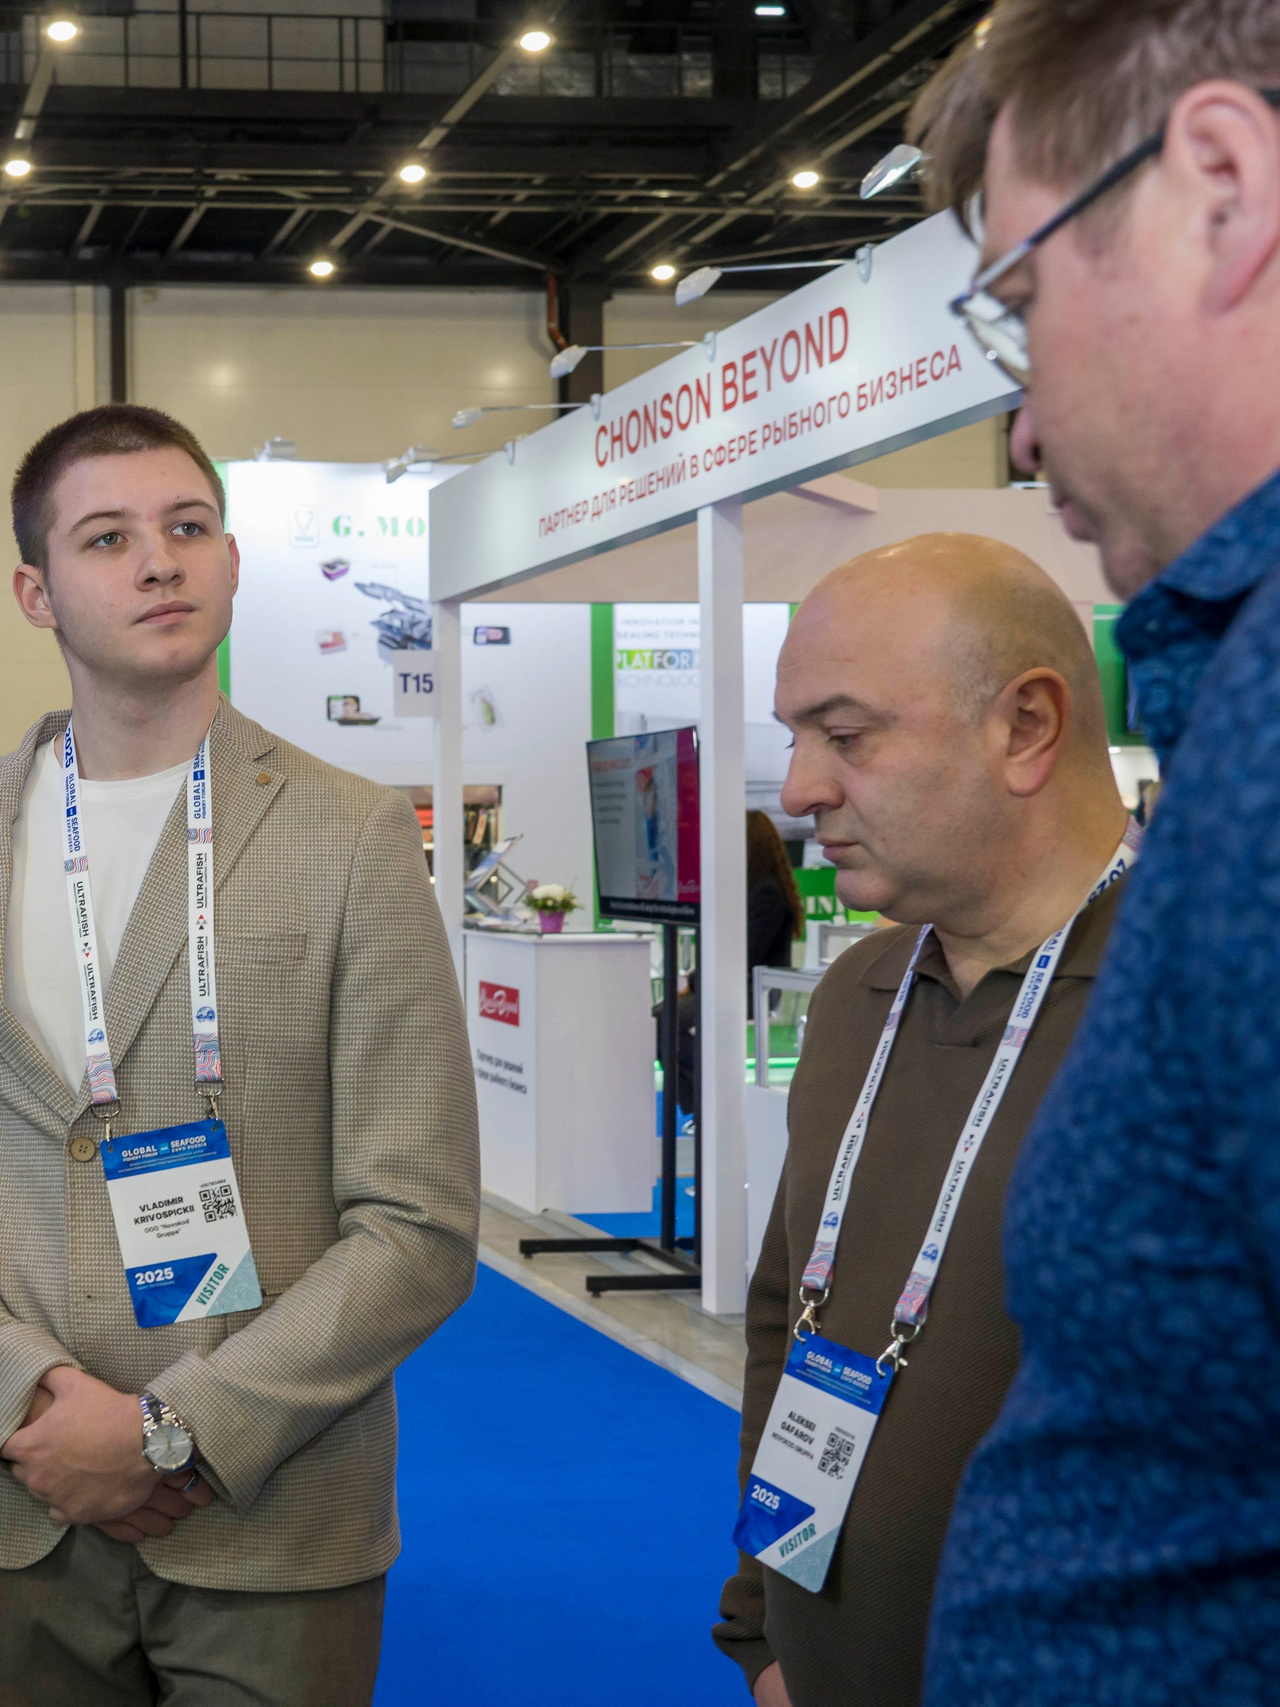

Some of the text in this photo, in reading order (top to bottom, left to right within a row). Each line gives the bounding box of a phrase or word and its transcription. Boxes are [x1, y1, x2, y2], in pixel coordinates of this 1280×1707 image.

[595, 306, 849, 467] CHONSON BEYOND
[538, 344, 962, 538] ПАРТНЕР ДЛЯ РЕШЕНИЙ В СФЕРЕ РЫБНОГО БИЗНЕСА
[399, 672, 434, 694] T15
[68, 772, 77, 806] GLOBAL
[193, 782, 201, 820] GLOBAL
[71, 817, 81, 852] SEAFOOD
[196, 852, 204, 909] ULTRAFISH
[76, 880, 90, 938] ULTRAFISH
[197, 935, 206, 998] ULTRAFISH
[86, 962, 99, 1021] ULTRAFISH
[1021, 971, 1044, 1019] SEAFOOD
[974, 1058, 1009, 1128] ULTRAFISH
[122, 1145, 157, 1158] GLOBAL
[170, 1135, 206, 1148] SEAFOOD
[832, 1134, 857, 1202] ULTRAFISH
[139, 1196, 184, 1213] VLADIMIR
[936, 1160, 965, 1233] ULTRAFISH
[133, 1205, 195, 1226] KRIVOSPICKII
[134, 1267, 174, 1285] 2025
[195, 1262, 230, 1306] VISITOR
[806, 1351, 833, 1369] GLOBAL
[780, 1421, 814, 1446] GAFAROV
[787, 1410, 817, 1432] ALEKSEI
[751, 1484, 780, 1510] 2025
[778, 1522, 817, 1558] VISITOR
